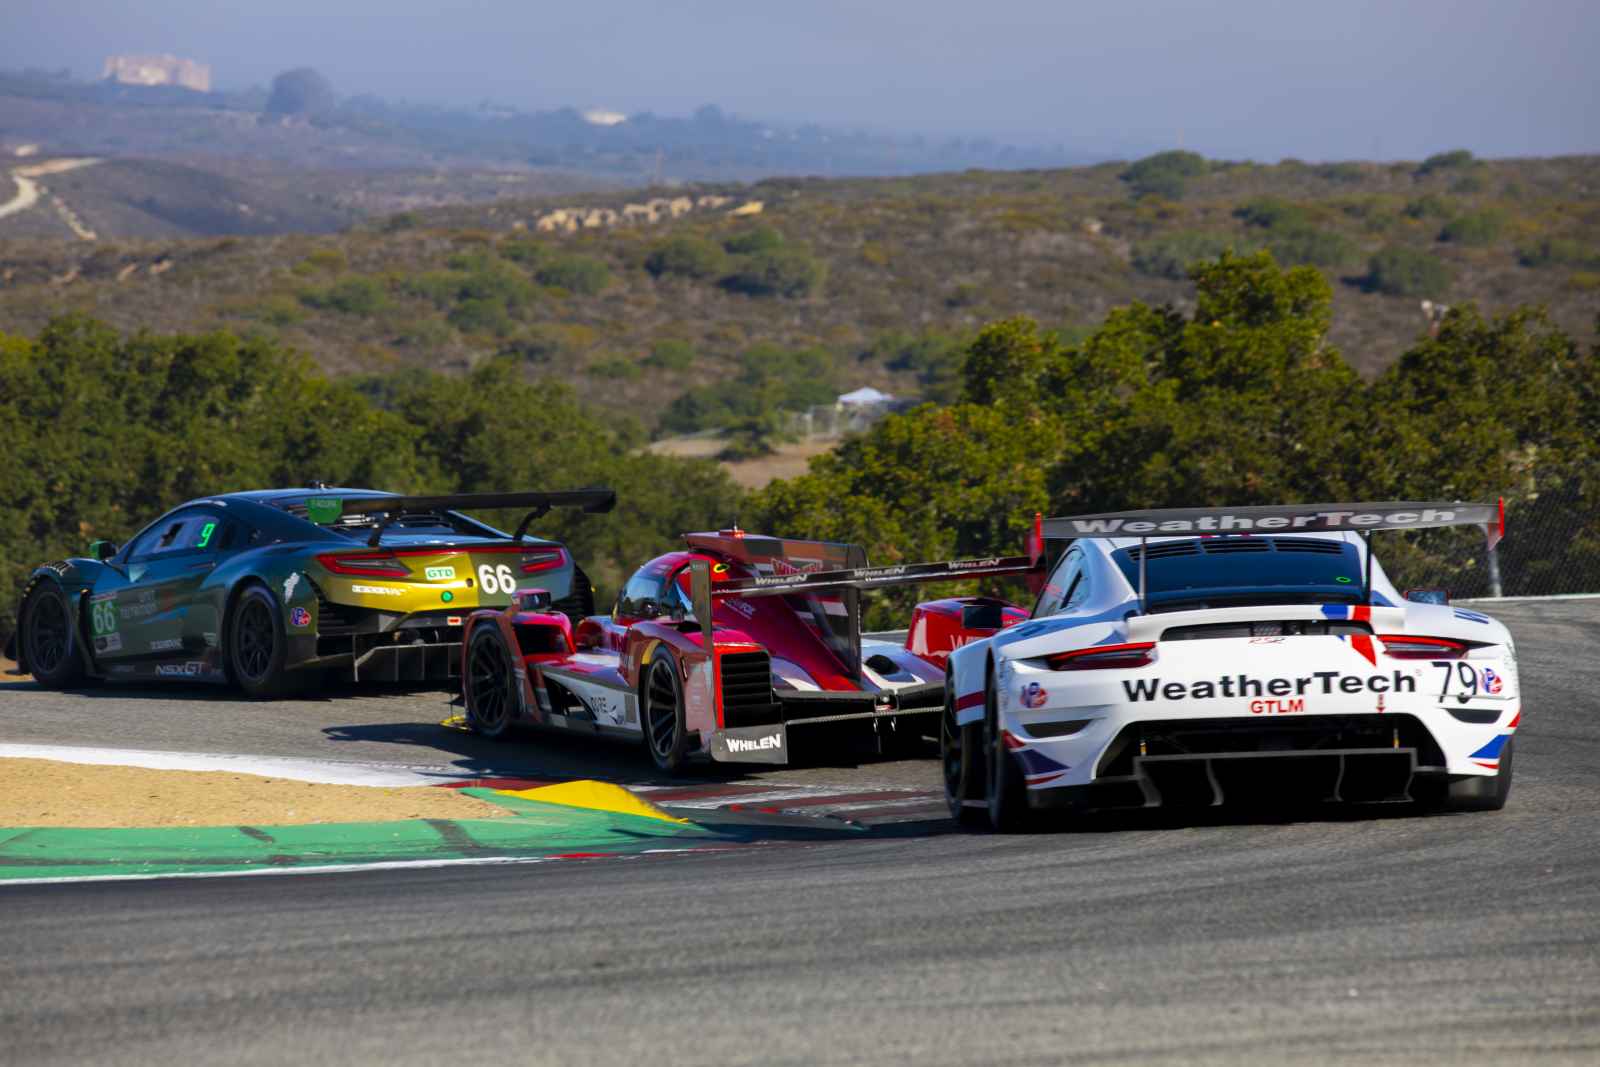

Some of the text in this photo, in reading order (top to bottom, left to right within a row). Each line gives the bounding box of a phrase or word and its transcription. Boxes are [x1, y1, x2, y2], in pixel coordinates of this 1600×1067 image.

[1071, 509, 1456, 533] WeatherTech
[426, 568, 453, 579] GTD
[853, 565, 906, 578] WHELEN
[948, 558, 1000, 570] WHELEN
[478, 564, 516, 594] 66
[754, 573, 808, 586] WHELEN
[92, 601, 115, 634] 66
[1121, 669, 1417, 703] WeatherTech
[1431, 661, 1478, 704] 79
[1250, 698, 1305, 714] GTLM
[726, 733, 782, 753] WHELEN
